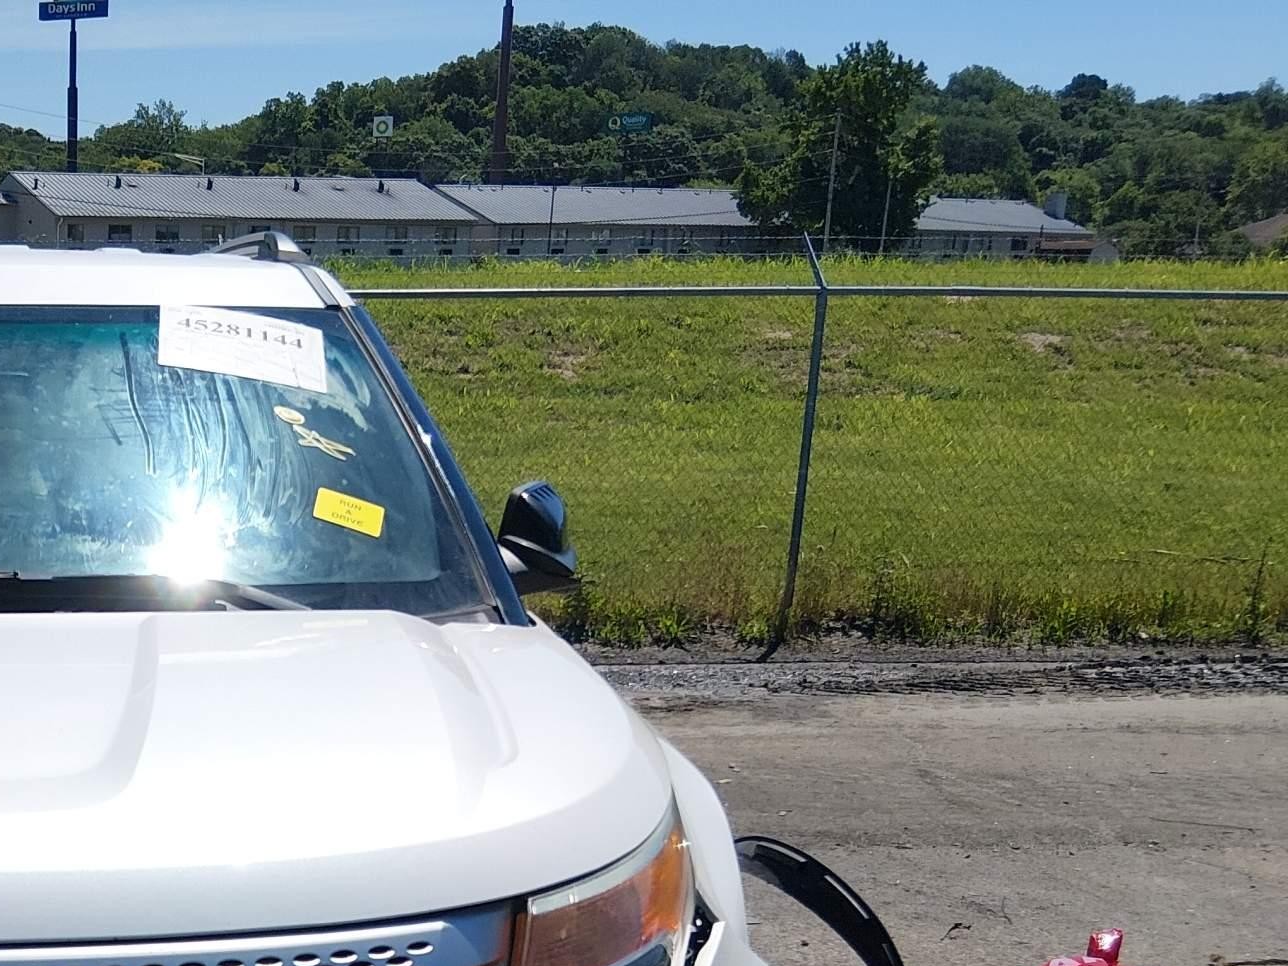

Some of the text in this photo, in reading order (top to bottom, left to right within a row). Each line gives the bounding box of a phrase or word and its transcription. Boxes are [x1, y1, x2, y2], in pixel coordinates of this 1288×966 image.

[177, 317, 303, 349] 45281144
[339, 499, 362, 512] RUN
[331, 511, 365, 527] DRIVE
